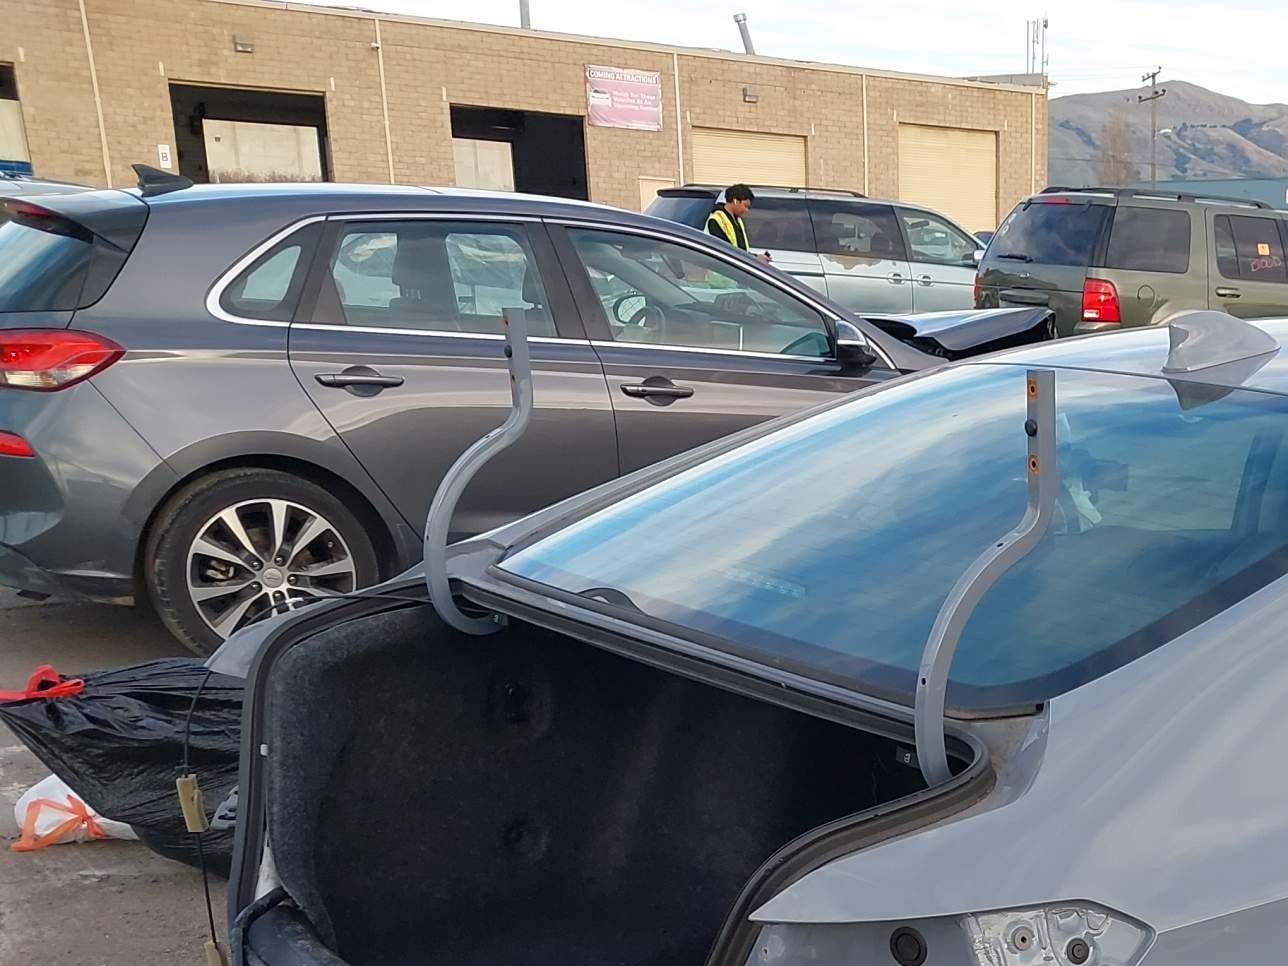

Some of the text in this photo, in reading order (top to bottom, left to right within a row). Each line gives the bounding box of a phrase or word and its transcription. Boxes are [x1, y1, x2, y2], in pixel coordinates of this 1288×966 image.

[590, 69, 657, 84] COMING ATTRACTIONS
[161, 152, 169, 162] B
